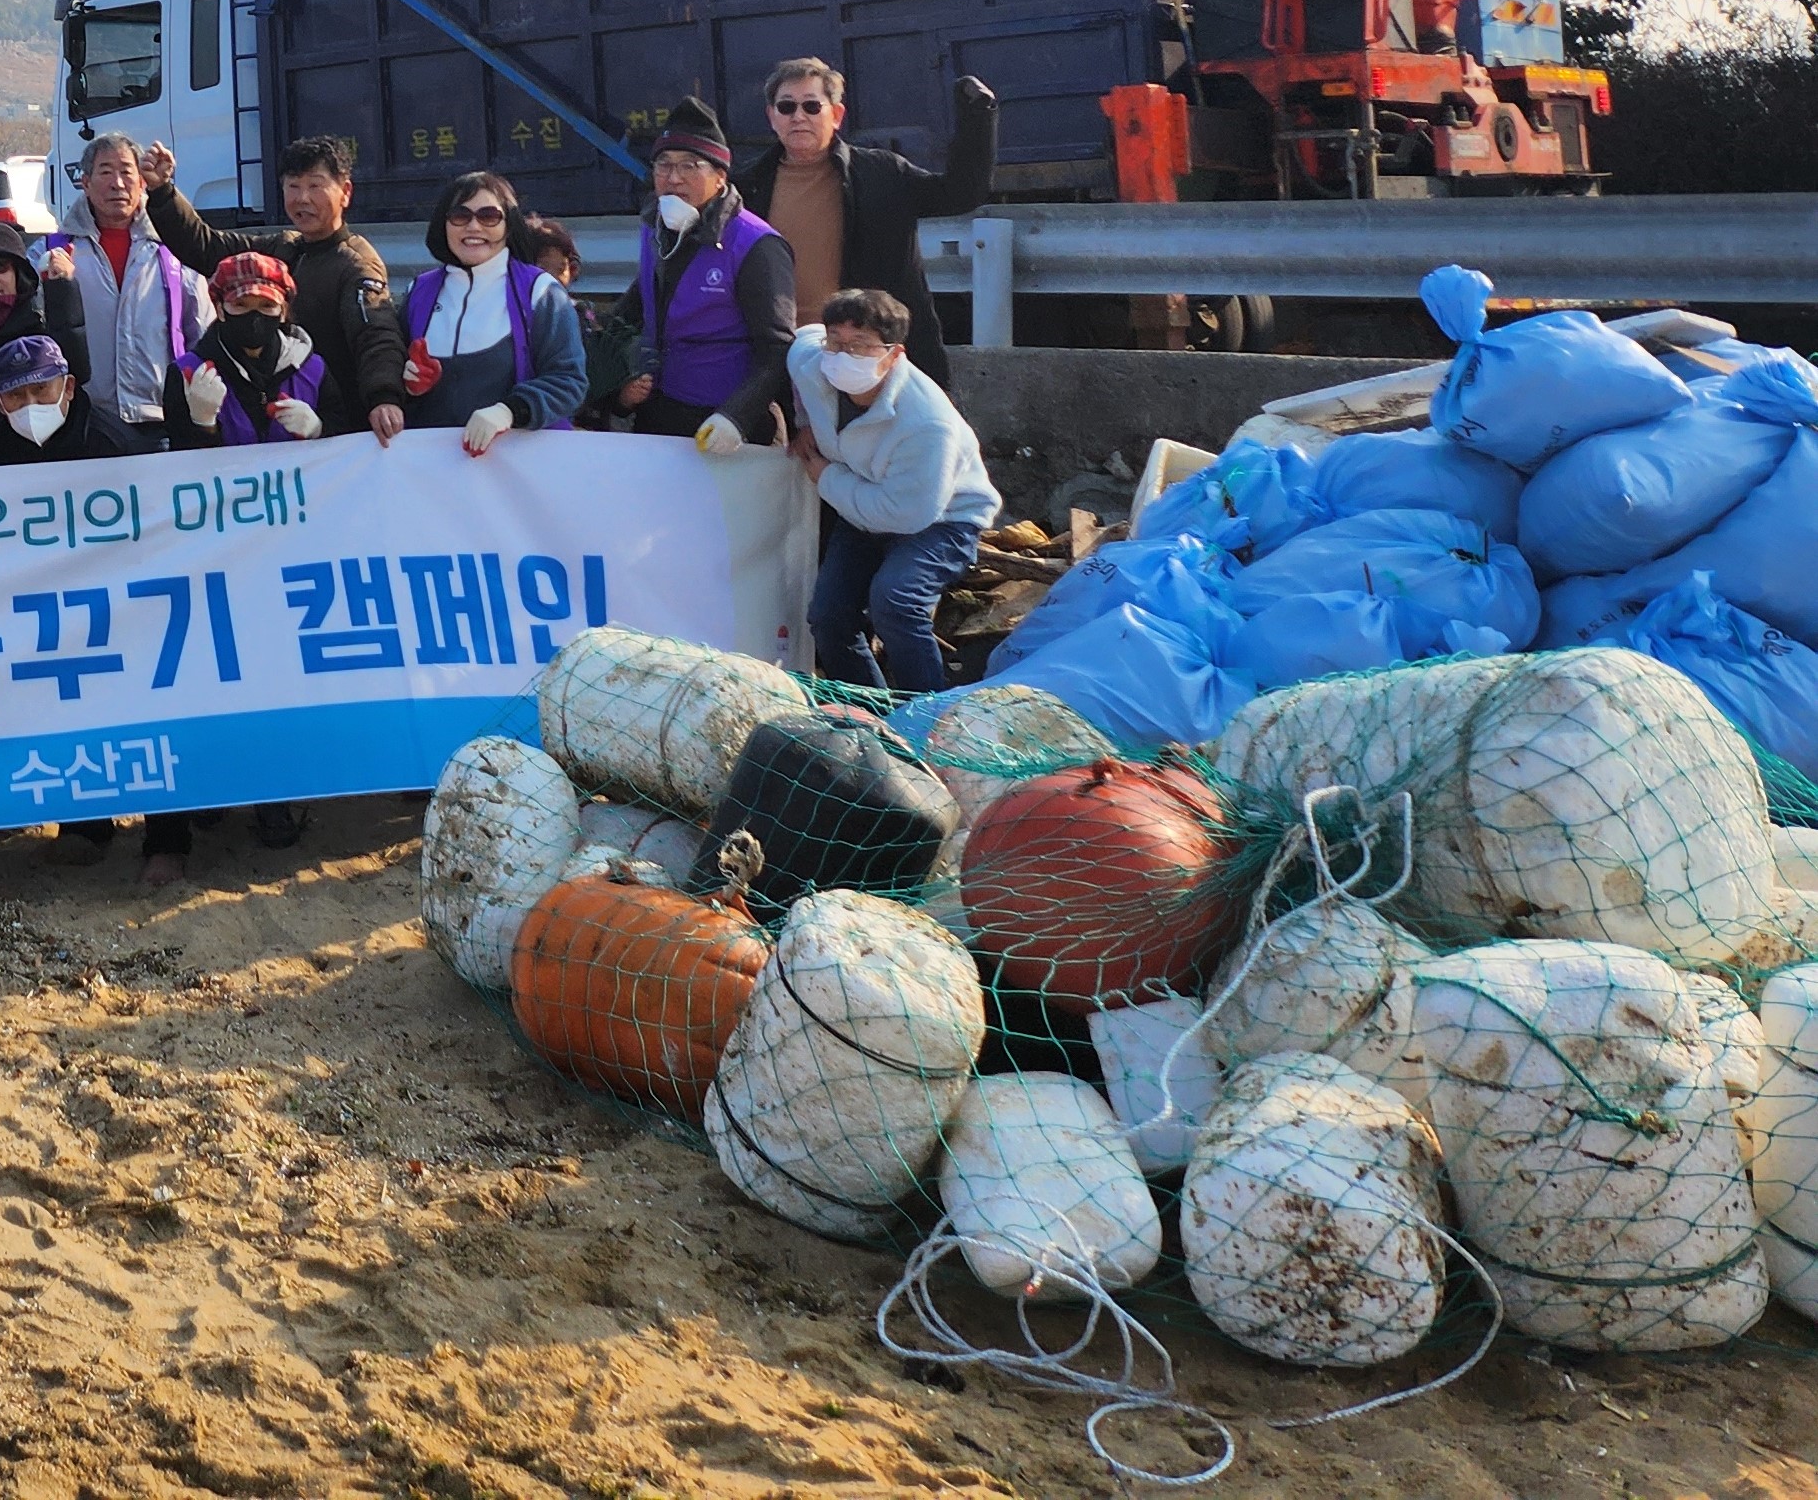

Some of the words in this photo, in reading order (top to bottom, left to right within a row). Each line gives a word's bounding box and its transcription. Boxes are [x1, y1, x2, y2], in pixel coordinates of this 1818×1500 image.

[410, 126, 457, 159] 용품
[511, 118, 562, 150] 수집
[172, 466, 308, 535] 미래!
[280, 552, 608, 675] 캠페인
[9, 734, 179, 806] 수산과
